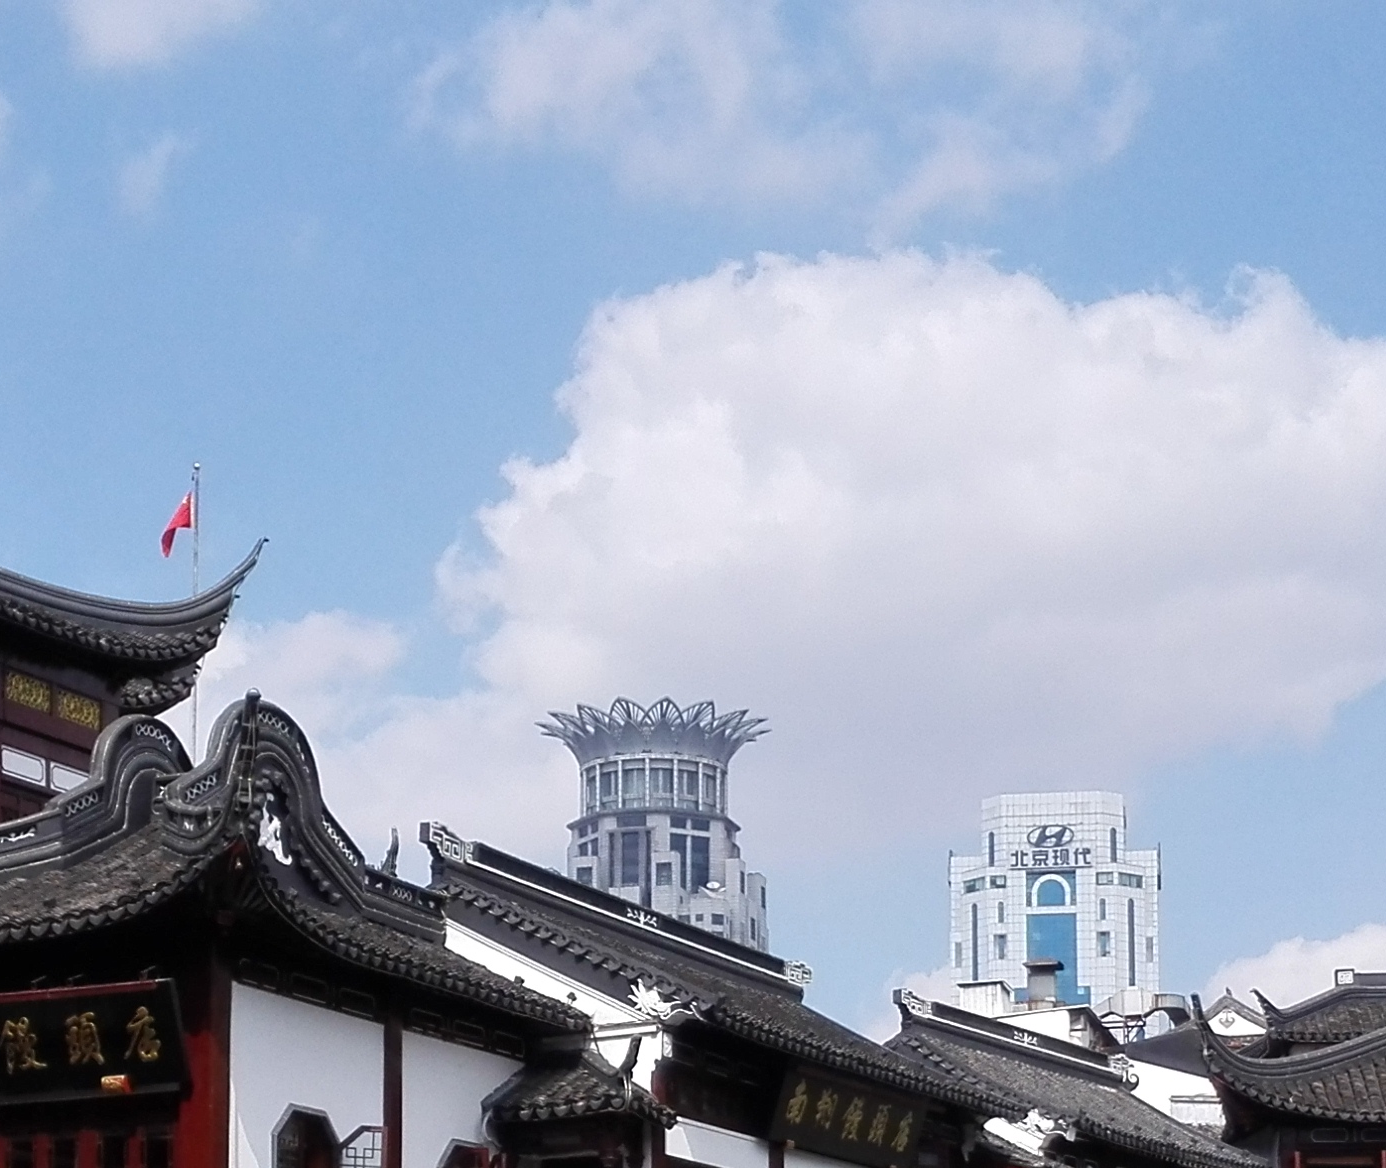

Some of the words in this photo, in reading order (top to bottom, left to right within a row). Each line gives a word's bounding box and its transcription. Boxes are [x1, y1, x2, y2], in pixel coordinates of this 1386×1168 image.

[1010, 847, 1092, 868] 北京现代
[785, 1078, 914, 1154] 南翔饅頭店
